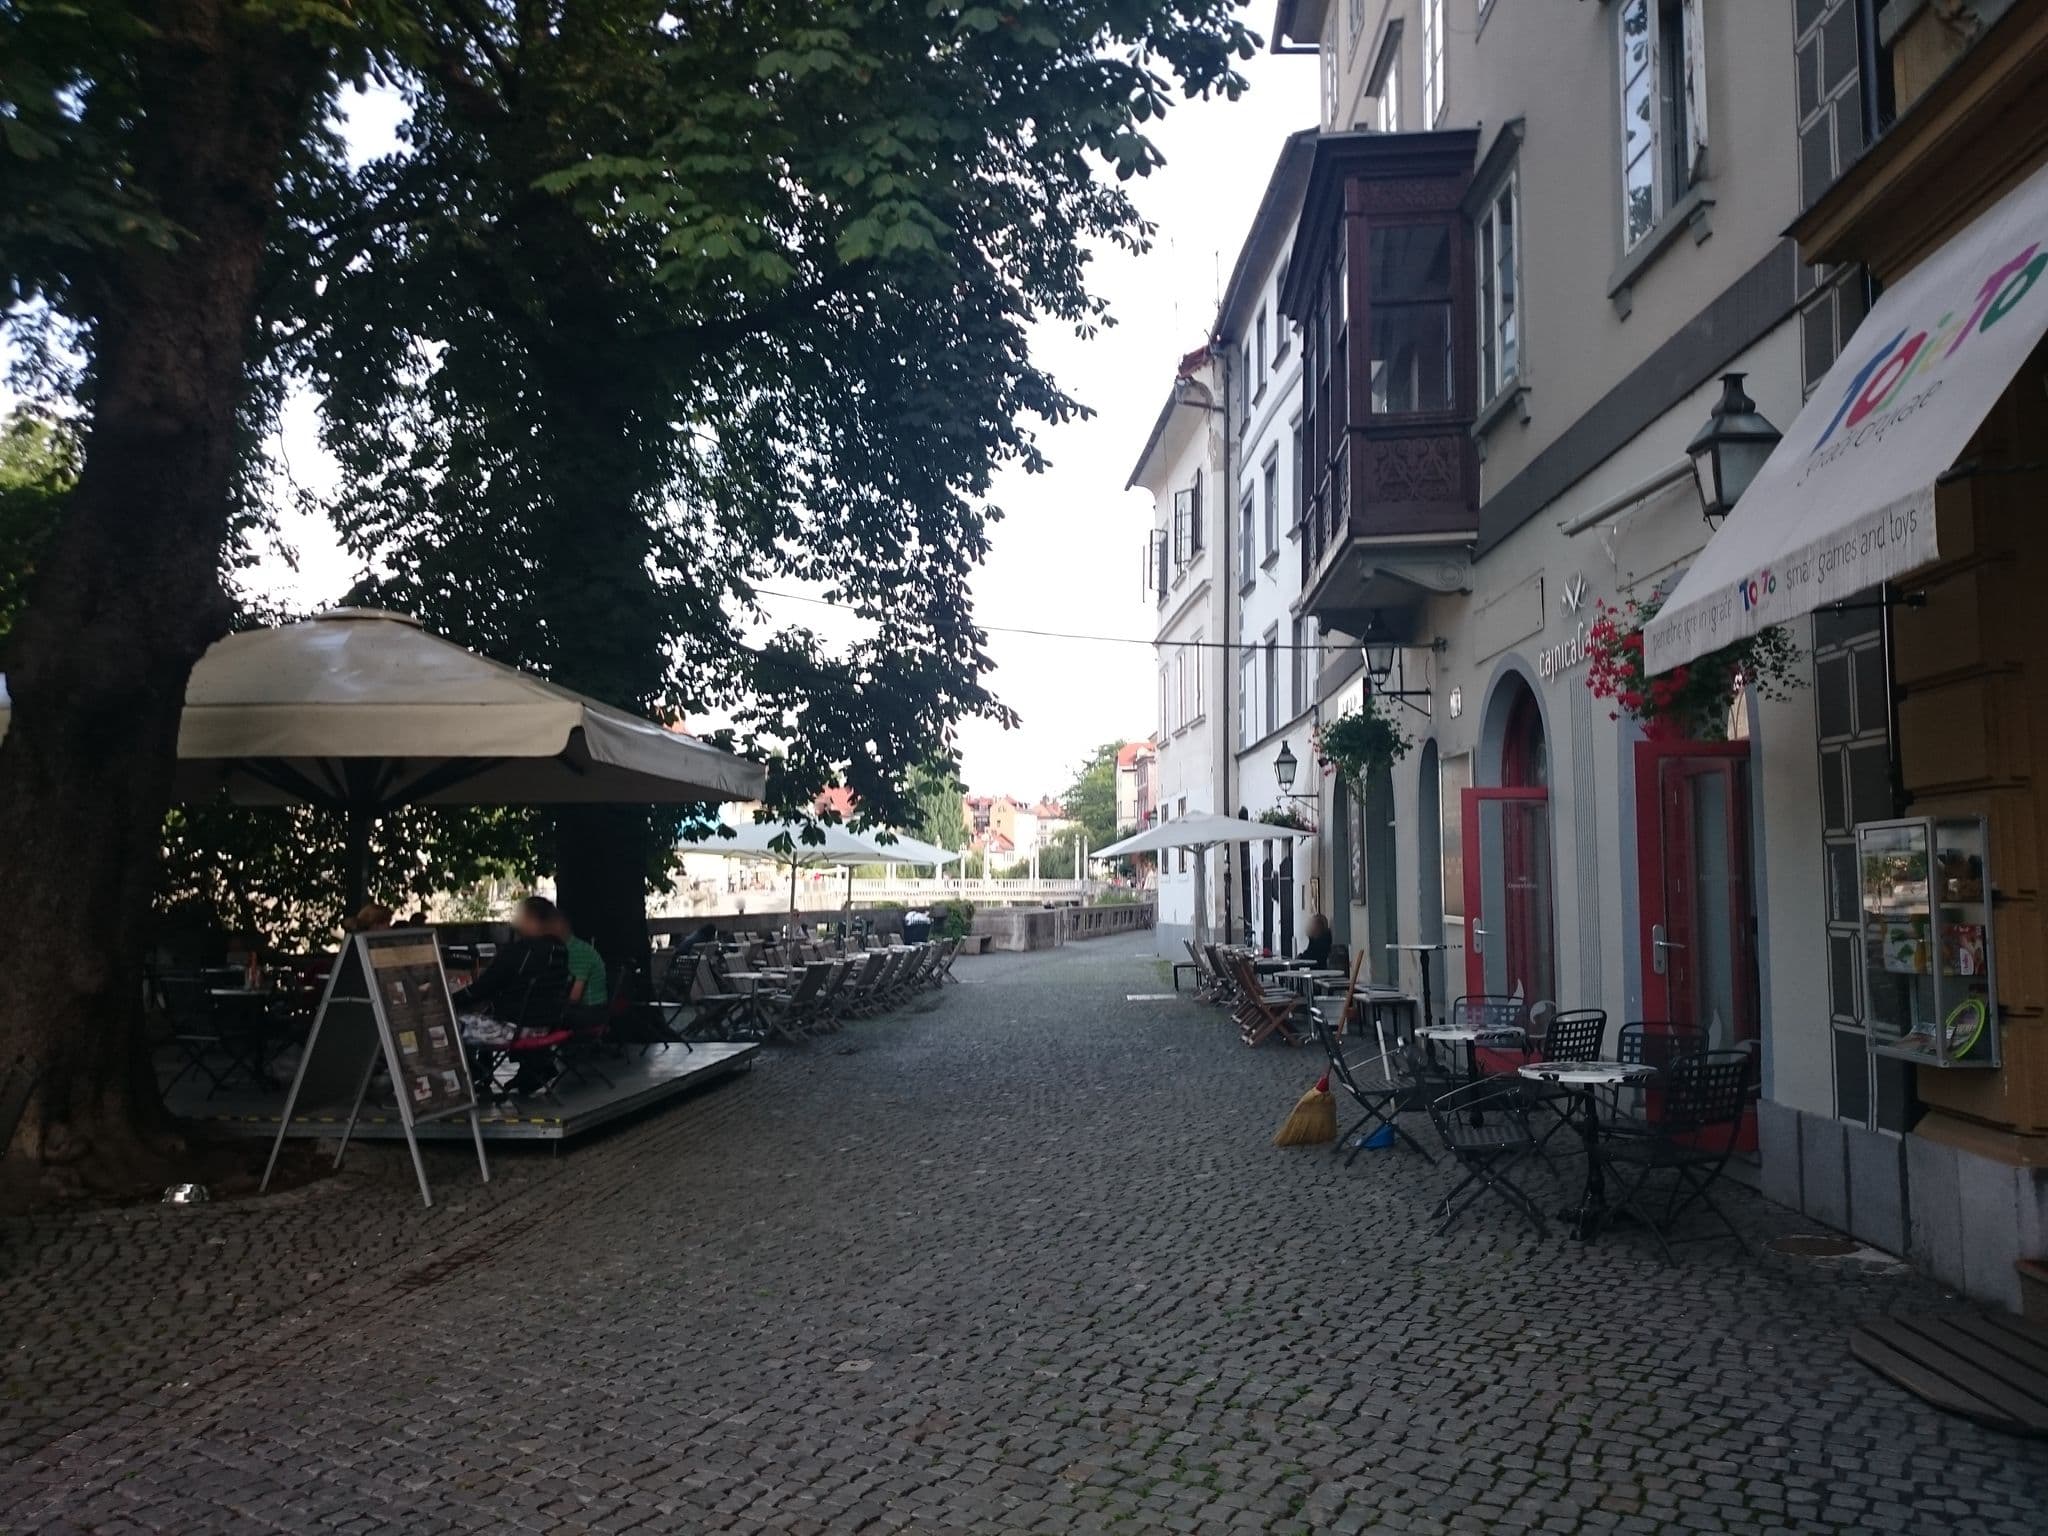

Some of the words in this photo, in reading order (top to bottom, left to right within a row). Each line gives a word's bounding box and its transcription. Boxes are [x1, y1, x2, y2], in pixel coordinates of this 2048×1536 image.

[1817, 537, 1857, 584] games
[1861, 516, 1886, 556] and
[1889, 508, 1918, 545] toys
